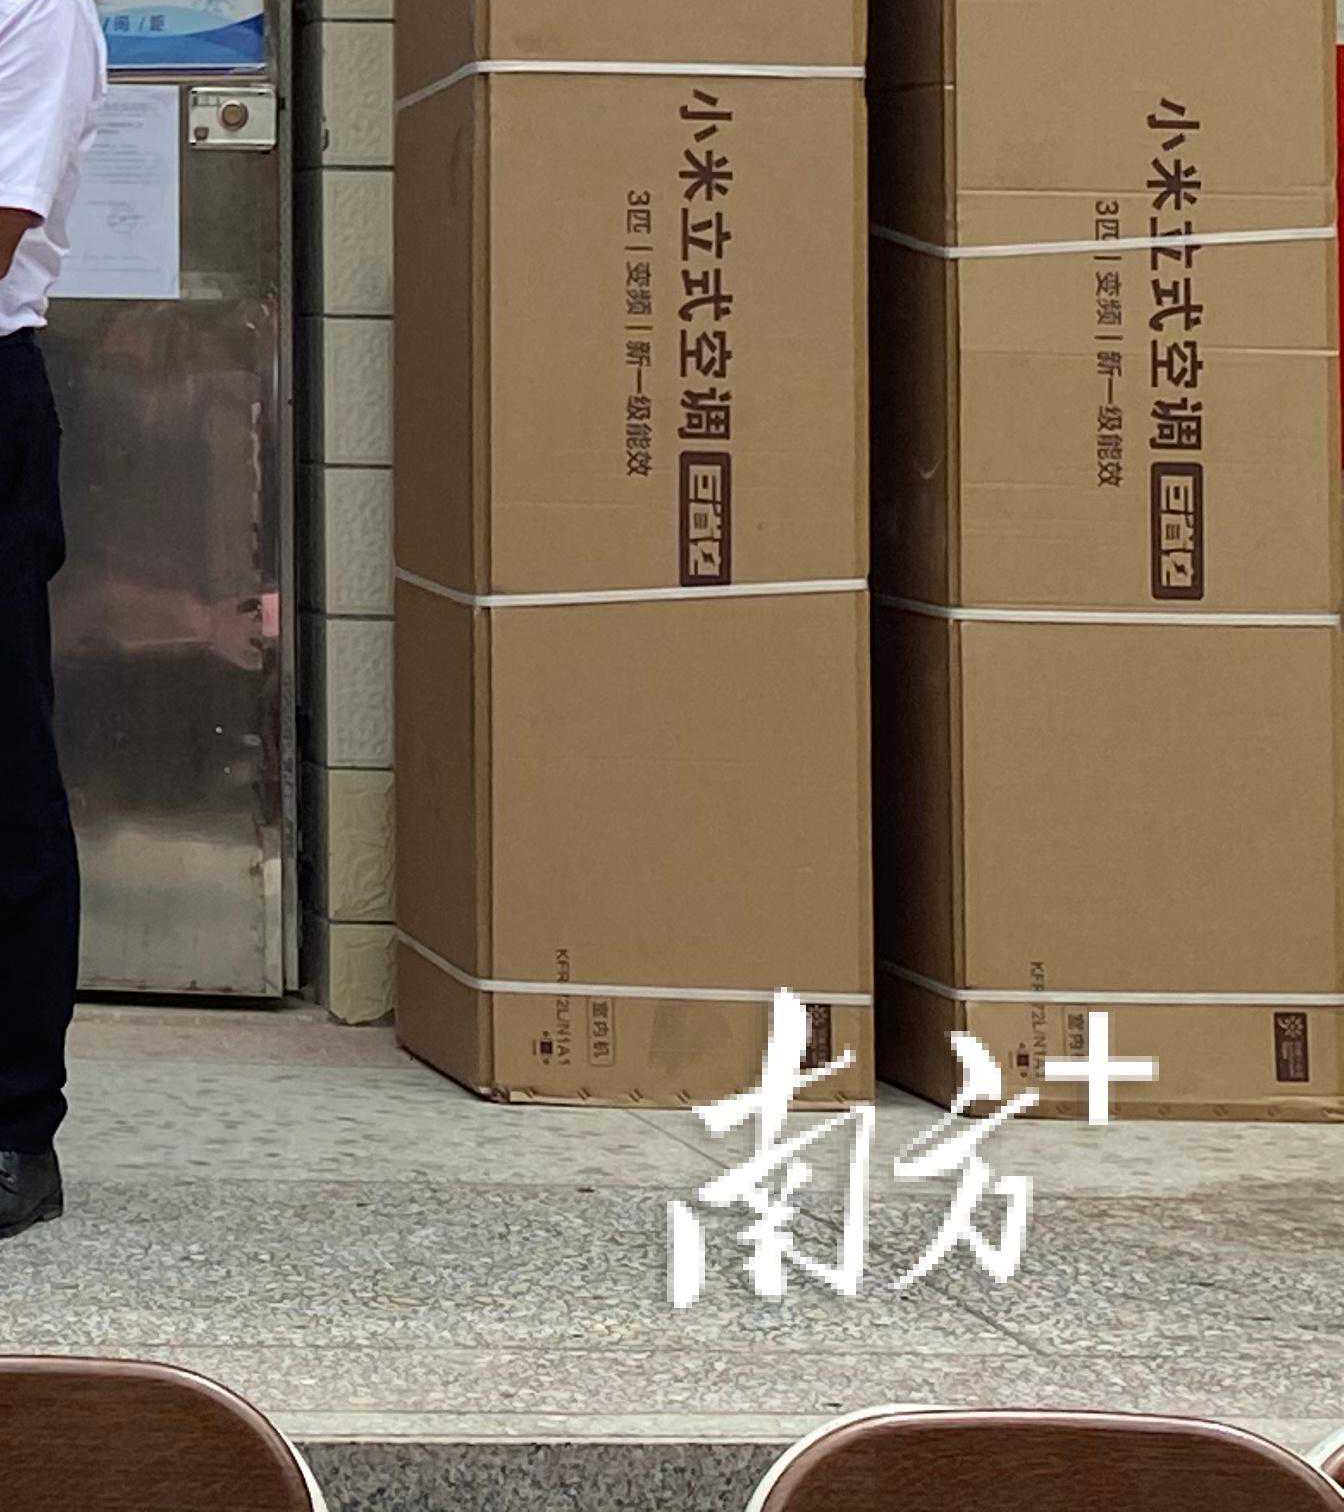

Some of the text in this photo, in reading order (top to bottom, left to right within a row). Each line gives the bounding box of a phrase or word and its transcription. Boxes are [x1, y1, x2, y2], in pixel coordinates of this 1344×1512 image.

[677, 88, 734, 441] 小米立式空调
[1146, 97, 1204, 451] 小米立式空调
